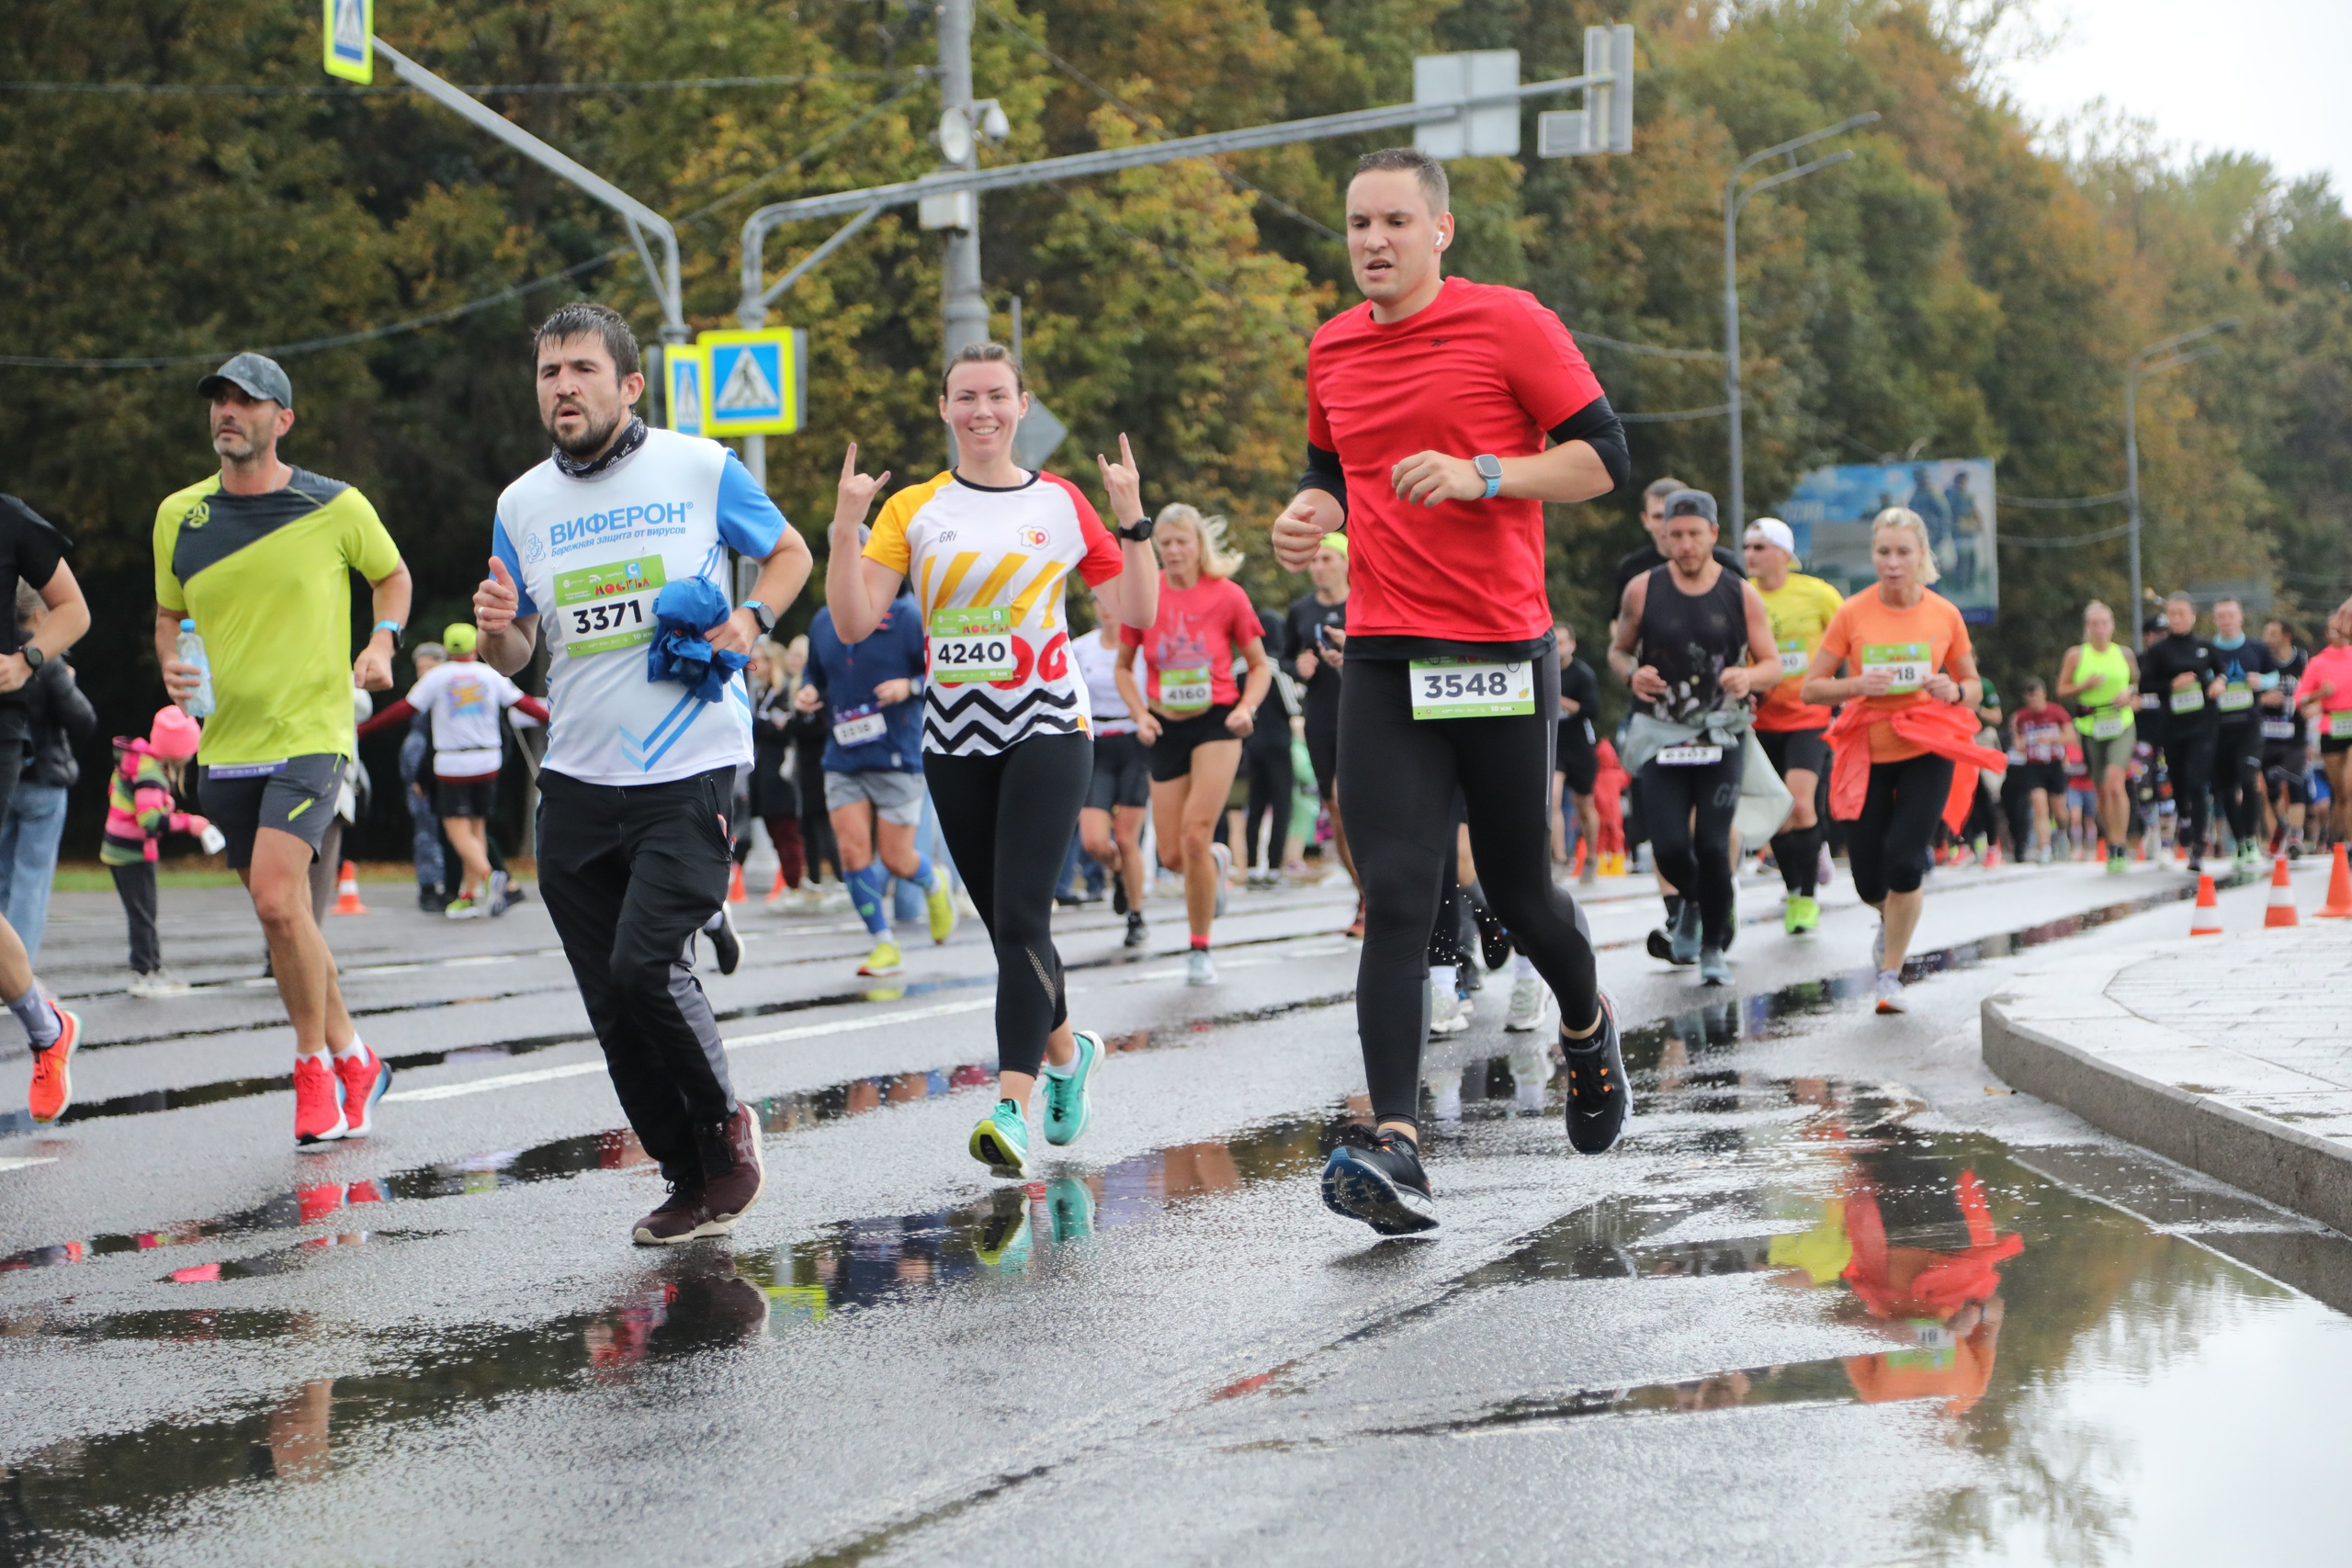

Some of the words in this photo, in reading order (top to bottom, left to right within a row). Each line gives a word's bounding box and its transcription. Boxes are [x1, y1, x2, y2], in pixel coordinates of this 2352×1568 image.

[551, 537, 594, 558] Бережная
[596, 530, 631, 545] защита
[634, 528, 645, 538] от
[647, 526, 685, 537] вирусов
[572, 599, 642, 634] 3371
[938, 641, 1006, 664] 4240
[1169, 688, 1206, 700] 4160
[1424, 671, 1509, 699] 3548
